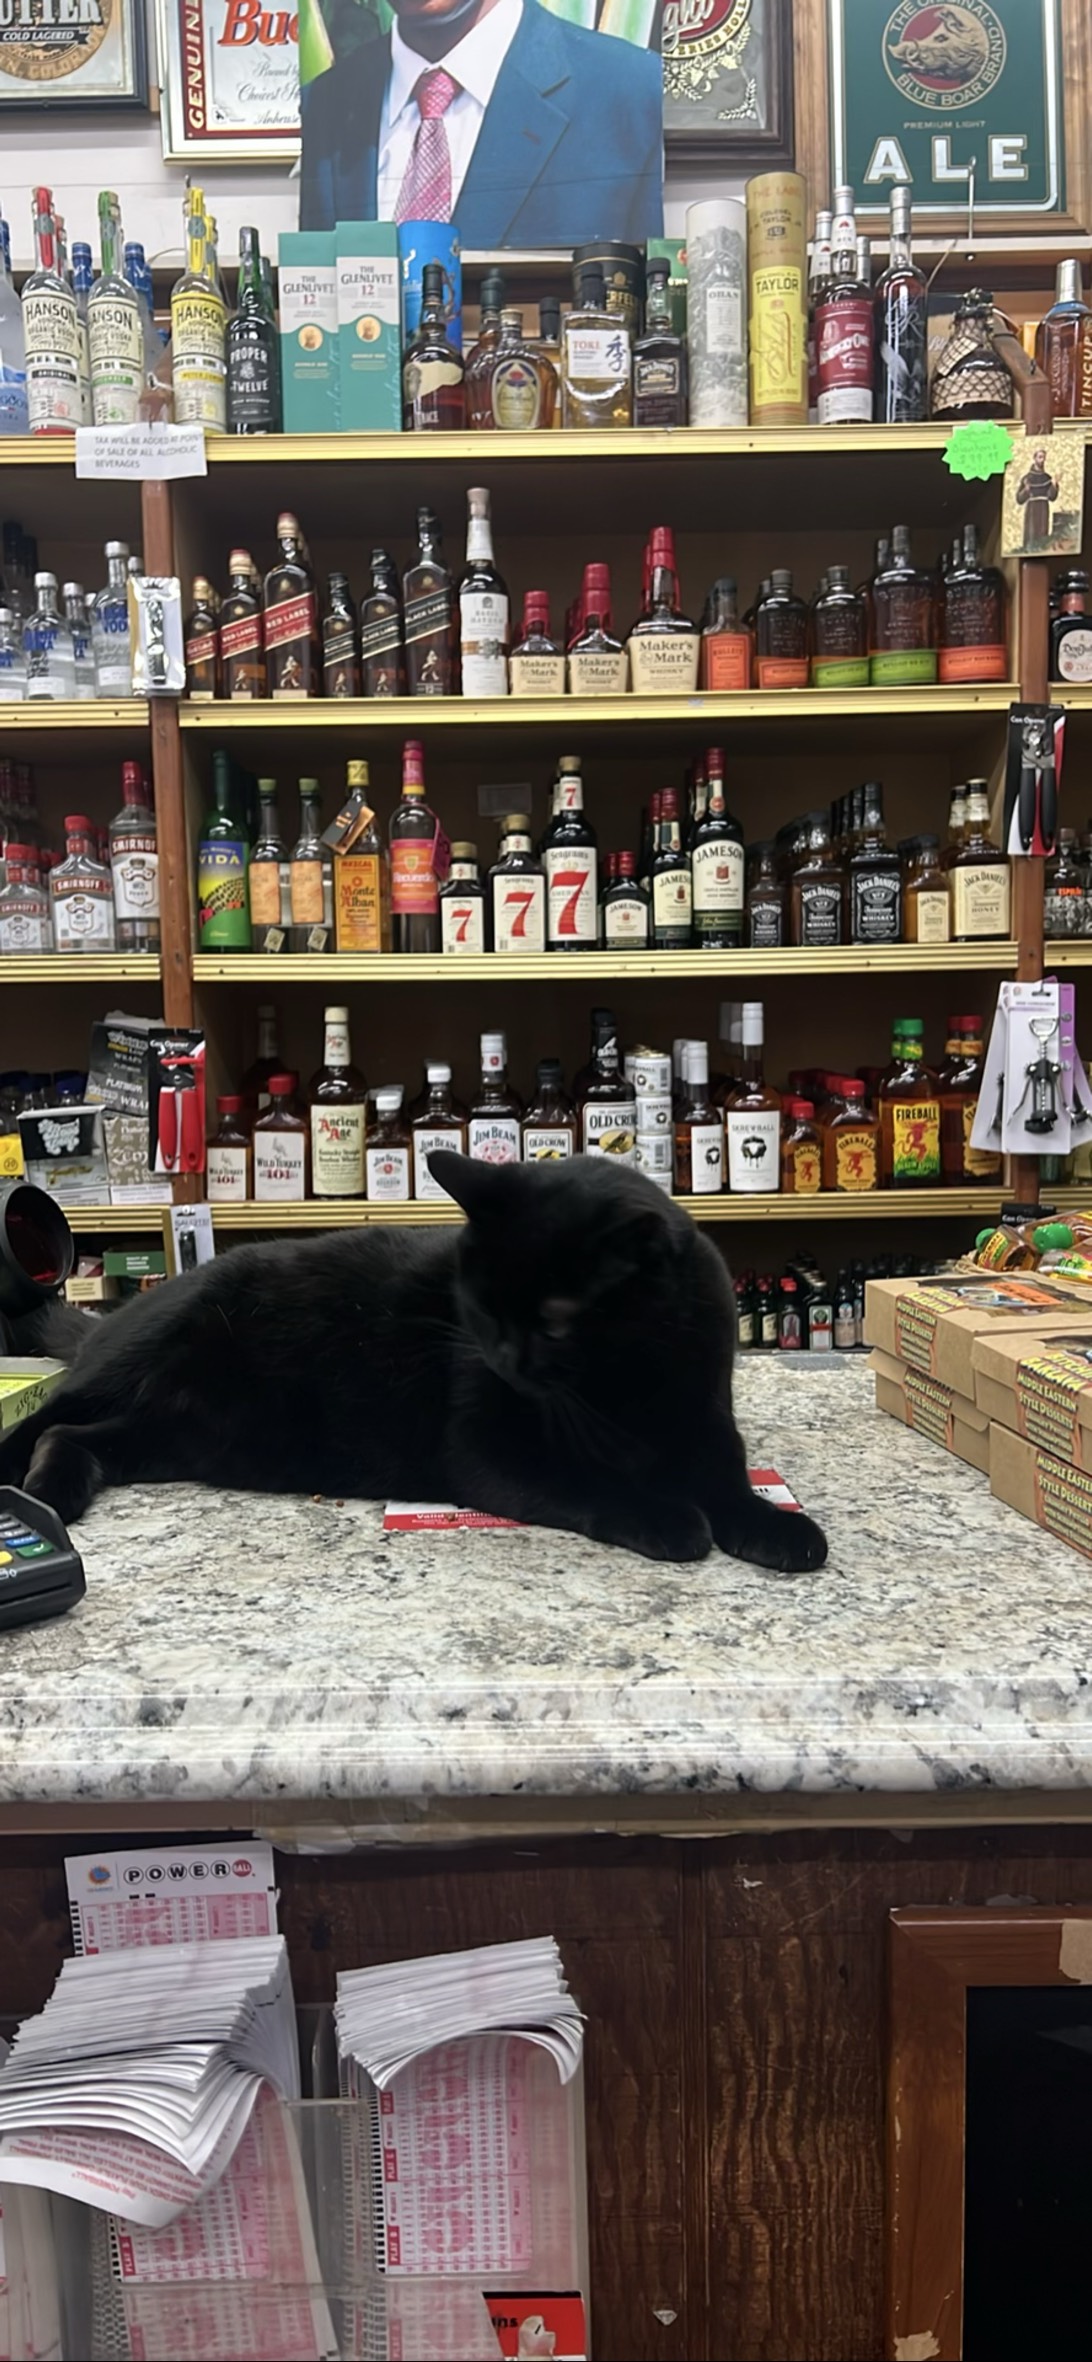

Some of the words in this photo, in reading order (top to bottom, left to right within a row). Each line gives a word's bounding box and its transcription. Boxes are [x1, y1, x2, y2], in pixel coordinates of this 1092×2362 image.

[889, 5, 918, 33] THE
[3, 31, 31, 41] COLD
[32, 30, 75, 41] LAGERED
[896, 74, 937, 106] BLUE
[941, 82, 986, 107] BOAR
[981, 26, 1003, 82] BRAND
[864, 135, 1028, 184] ALE
[341, 274, 393, 285] GLENLIVET
[756, 277, 799, 294] TAYLOR
[283, 283, 336, 294] GLENLIVET
[361, 284, 374, 296] 12
[303, 294, 316, 305] 12
[26, 303, 76, 325] HANSON
[572, 341, 600, 351] TOKI
[230, 346, 268, 364] PROPER
[231, 378, 269, 393] TWELVE
[131, 437, 141, 445] BE
[94, 448, 105, 456] OF
[107, 448, 125, 456] SALE
[139, 448, 153, 456] ALL
[94, 460, 141, 469] BEVERAGES
[266, 617, 283, 629] RED
[283, 606, 311, 623] LABEL
[639, 639, 694, 651] Maker's
[519, 659, 558, 668] Maker's
[577, 657, 620, 667] Maker's
[653, 652, 693, 664] Mark
[530, 668, 558, 677] Mark
[589, 667, 620, 677] Mark
[565, 788, 577, 807] 7
[113, 838, 158, 853] SMIRNOF
[199, 853, 241, 865] VIDA
[696, 844, 743, 864] JAMESON
[341, 859, 373, 868] MEZCAL
[57, 880, 100, 891] SMIRNOFF
[964, 874, 981, 888] JACK
[981, 871, 1007, 887] DANIEL'S
[340, 885, 375, 896] Monte
[856, 880, 873, 894] JACK
[549, 870, 590, 935] 7
[801, 889, 818, 902] JACK
[504, 891, 536, 937] 7
[609, 903, 643, 913] JAMESON
[751, 905, 764, 915] JACK
[450, 909, 473, 942] 7
[106, 1077, 143, 1094] PLATINUM
[896, 1106, 938, 1122] FIREBALL
[318, 1116, 359, 1133] Ancient
[589, 1114, 613, 1129] OLD
[732, 1124, 775, 1133] SKREWBALL
[473, 1129, 491, 1146] JIM
[491, 1126, 516, 1145] BEAM
[529, 1138, 545, 1148] OLD
[544, 1137, 566, 1148] CROW
[839, 1134, 875, 1151] FIREBALL
[419, 1139, 434, 1153] JIM
[434, 1136, 457, 1151] BEAM
[257, 1158, 275, 1168] WILD
[275, 1156, 302, 1168] TURKEY
[374, 1157, 386, 1168] JIM
[385, 1153, 403, 1166] BEAM
[216, 1176, 235, 1184] 101
[266, 1168, 291, 1180] 101
[904, 1373, 926, 1393] MIDDLE
[926, 1384, 951, 1407] EASTERN
[1017, 1370, 1043, 1395] MIDDLE
[1044, 1386, 1077, 1412] EASTERN
[1019, 1391, 1039, 1411] STYLE
[1040, 1402, 1074, 1430] DESSERTS
[1037, 1455, 1066, 1480] MIDDLE
[1038, 1475, 1060, 1495] STYLE
